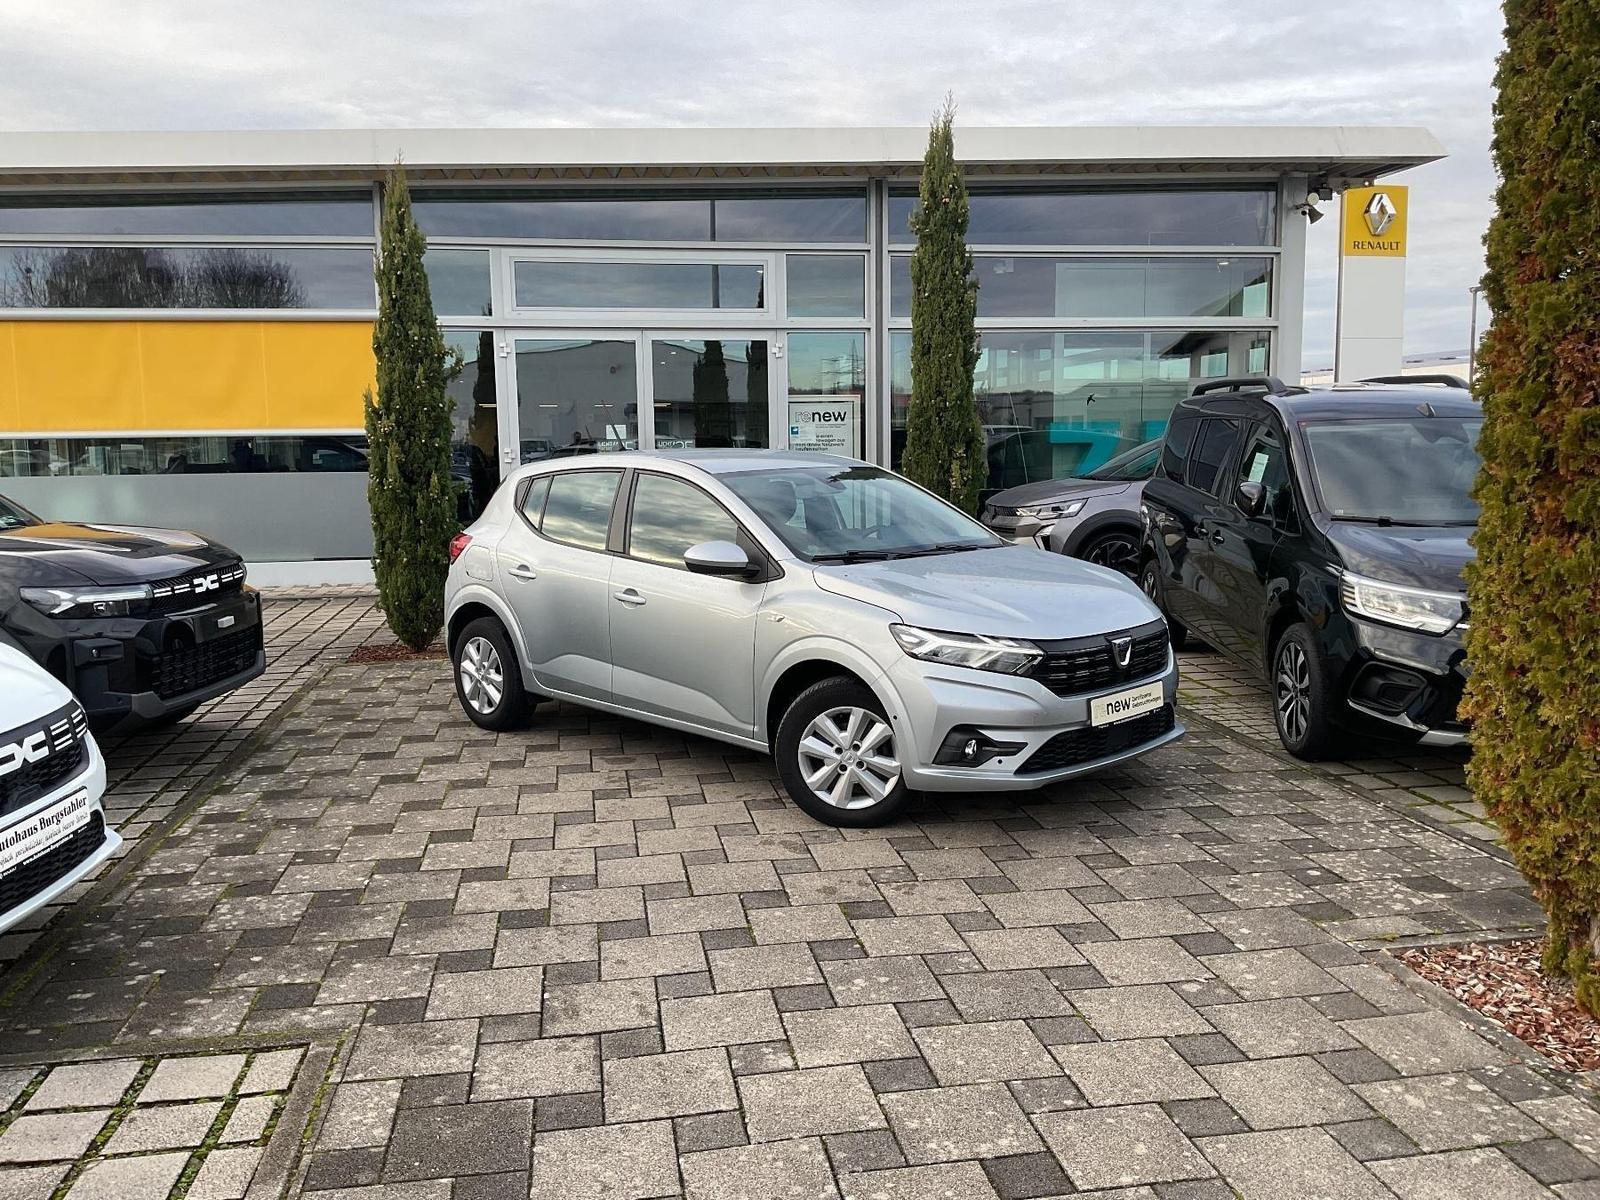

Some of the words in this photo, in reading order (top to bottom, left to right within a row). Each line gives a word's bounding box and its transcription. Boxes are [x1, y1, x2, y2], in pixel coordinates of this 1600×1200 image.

[1353, 240, 1401, 251] RENAULT
[0, 823, 38, 852] utohaus
[39, 796, 88, 831] Burgstahler
